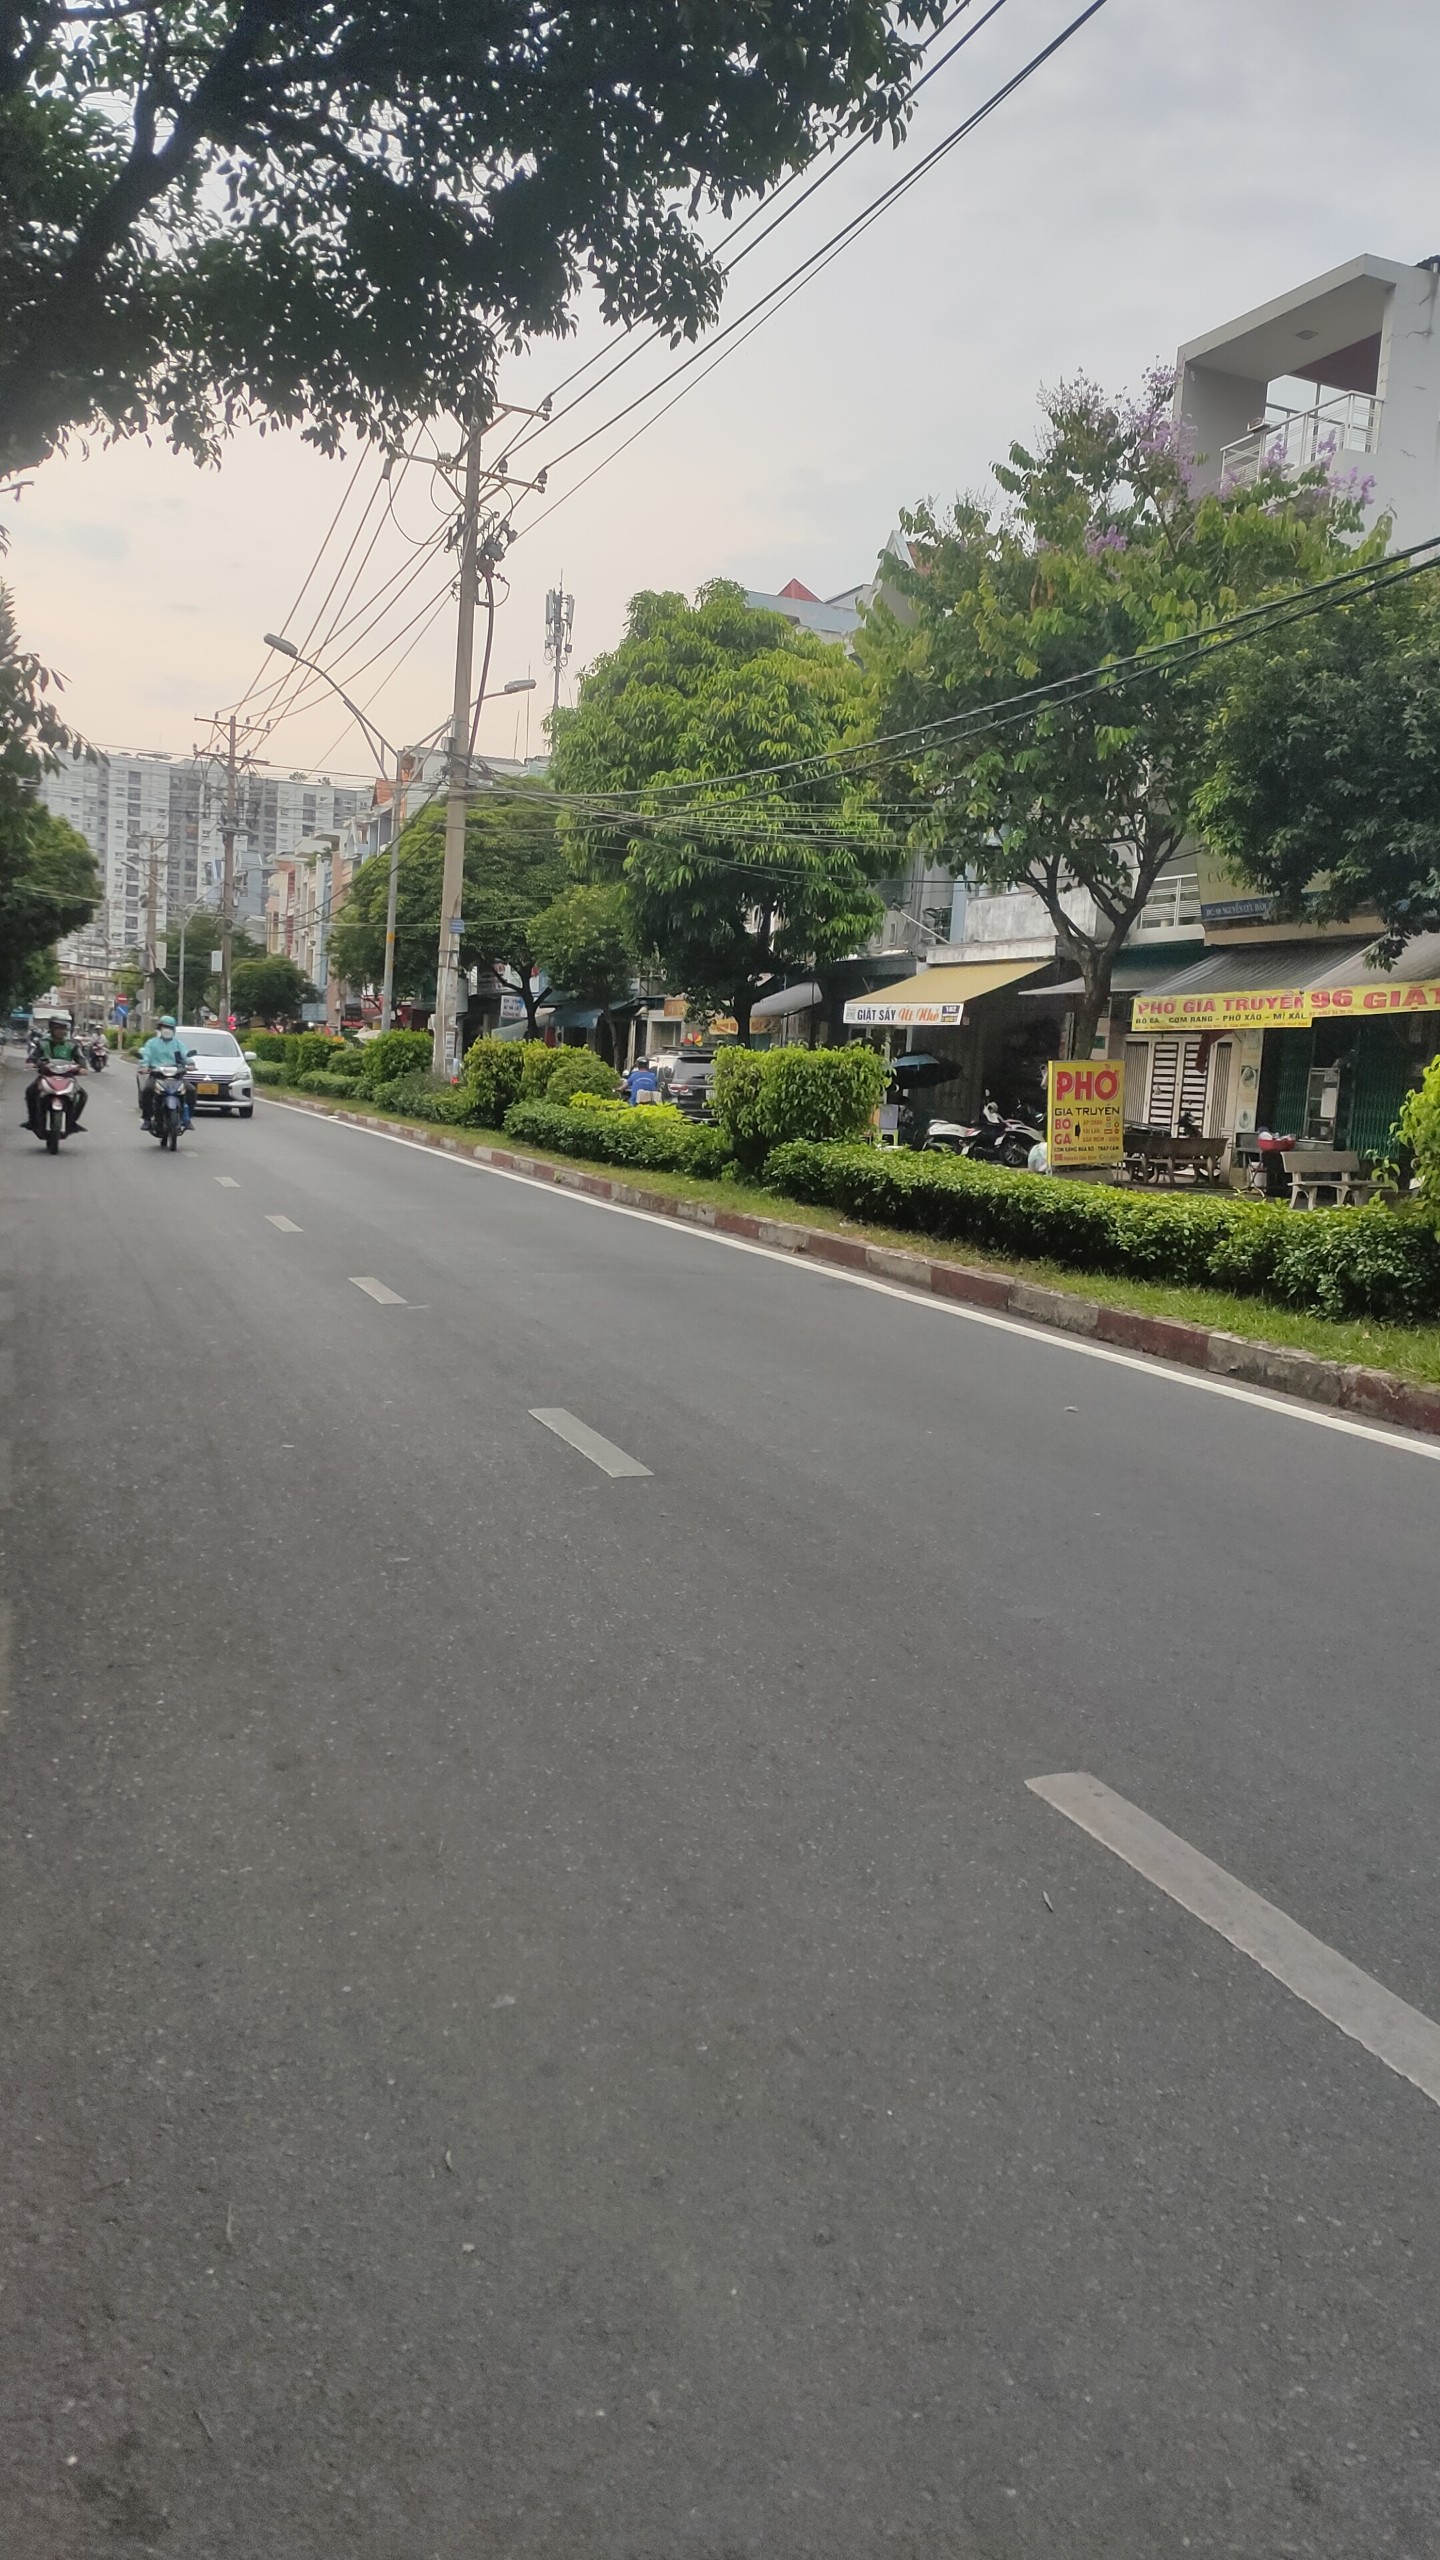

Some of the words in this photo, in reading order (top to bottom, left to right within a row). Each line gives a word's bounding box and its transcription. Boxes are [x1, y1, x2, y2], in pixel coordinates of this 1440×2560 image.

[1182, 998, 1216, 1013] GIA
[1310, 989, 1353, 1009] 96
[878, 1005, 896, 1021] SẤY
[1056, 1063, 1120, 1102] PHỞ
[1054, 1107, 1074, 1117] GIA
